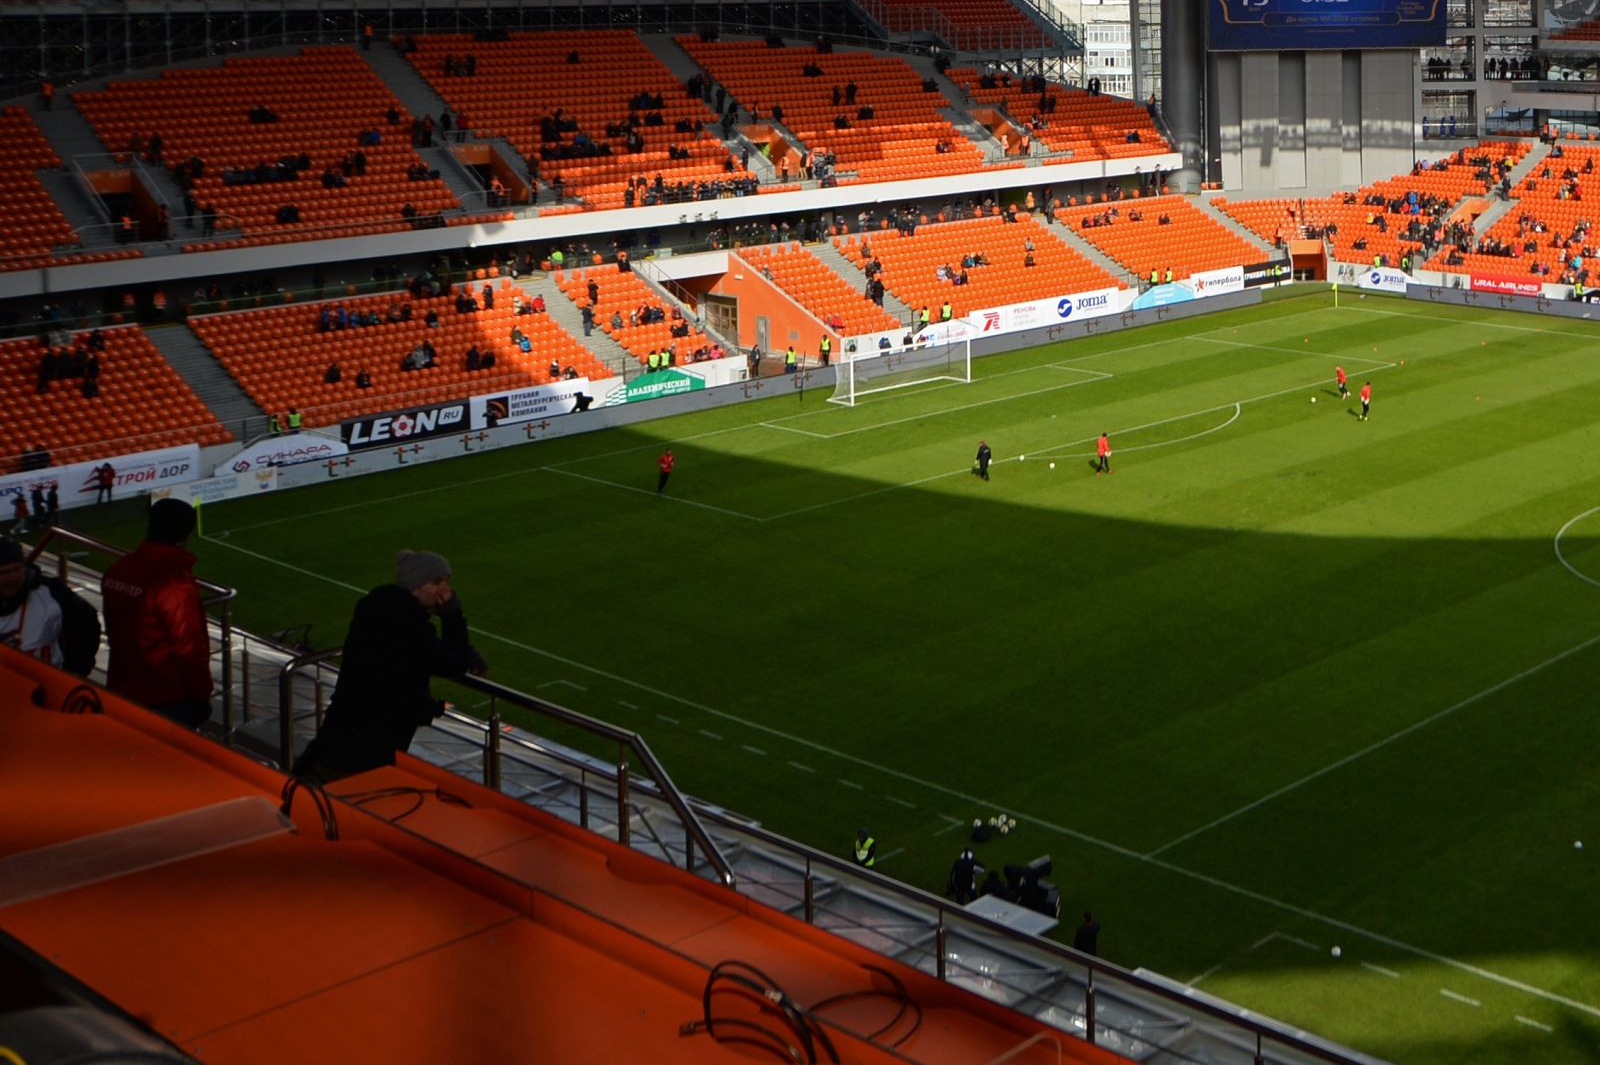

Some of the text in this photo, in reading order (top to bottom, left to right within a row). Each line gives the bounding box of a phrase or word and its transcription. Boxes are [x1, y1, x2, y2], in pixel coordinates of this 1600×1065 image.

[1205, 276, 1242, 287] гипербола
[1473, 278, 1498, 288] URAL
[1499, 281, 1539, 293] AIRLINES
[511, 390, 540, 401] ТРУБНАЯ
[628, 377, 691, 397] АКАДЕМИЧЕСКИЙ
[511, 392, 576, 409] МЕТАЛЛУРГИЧЕСКА
[511, 405, 547, 417] КОМПАНИЯ
[349, 408, 439, 446] LEON
[256, 444, 332, 465] СИНАРА
[116, 468, 157, 487] ТРОЙ
[159, 464, 190, 480] ДОР
